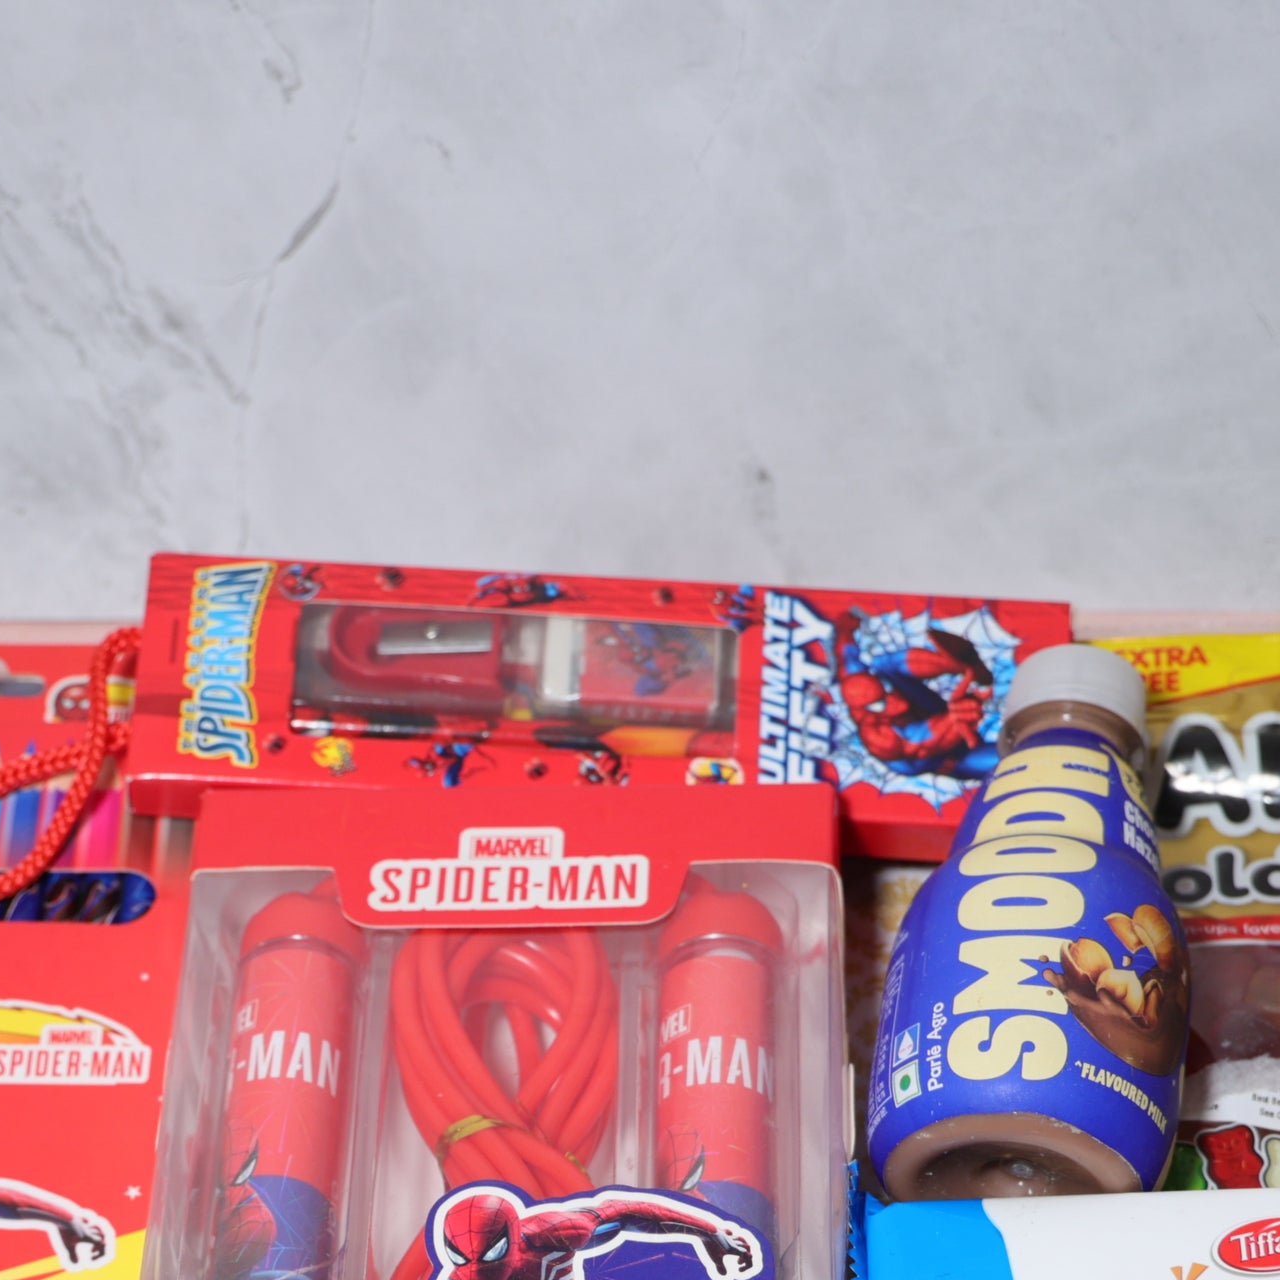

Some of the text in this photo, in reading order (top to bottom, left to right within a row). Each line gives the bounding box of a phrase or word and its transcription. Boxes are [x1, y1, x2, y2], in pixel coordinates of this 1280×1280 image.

[195, 561, 273, 768] SPIDER-MAN
[1114, 645, 1208, 668] XTRA
[757, 591, 791, 783] ULTIMATE
[787, 597, 836, 783] FIFTY
[1141, 671, 1179, 693] EE
[474, 838, 549, 858] MARVEL
[378, 862, 638, 905] SPIDER-MAN
[946, 744, 1111, 1081] SMOODH
[47, 1029, 96, 1046] MARVEL
[927, 1001, 945, 1041] Agro
[1147, 1101, 1168, 1136] MILK
